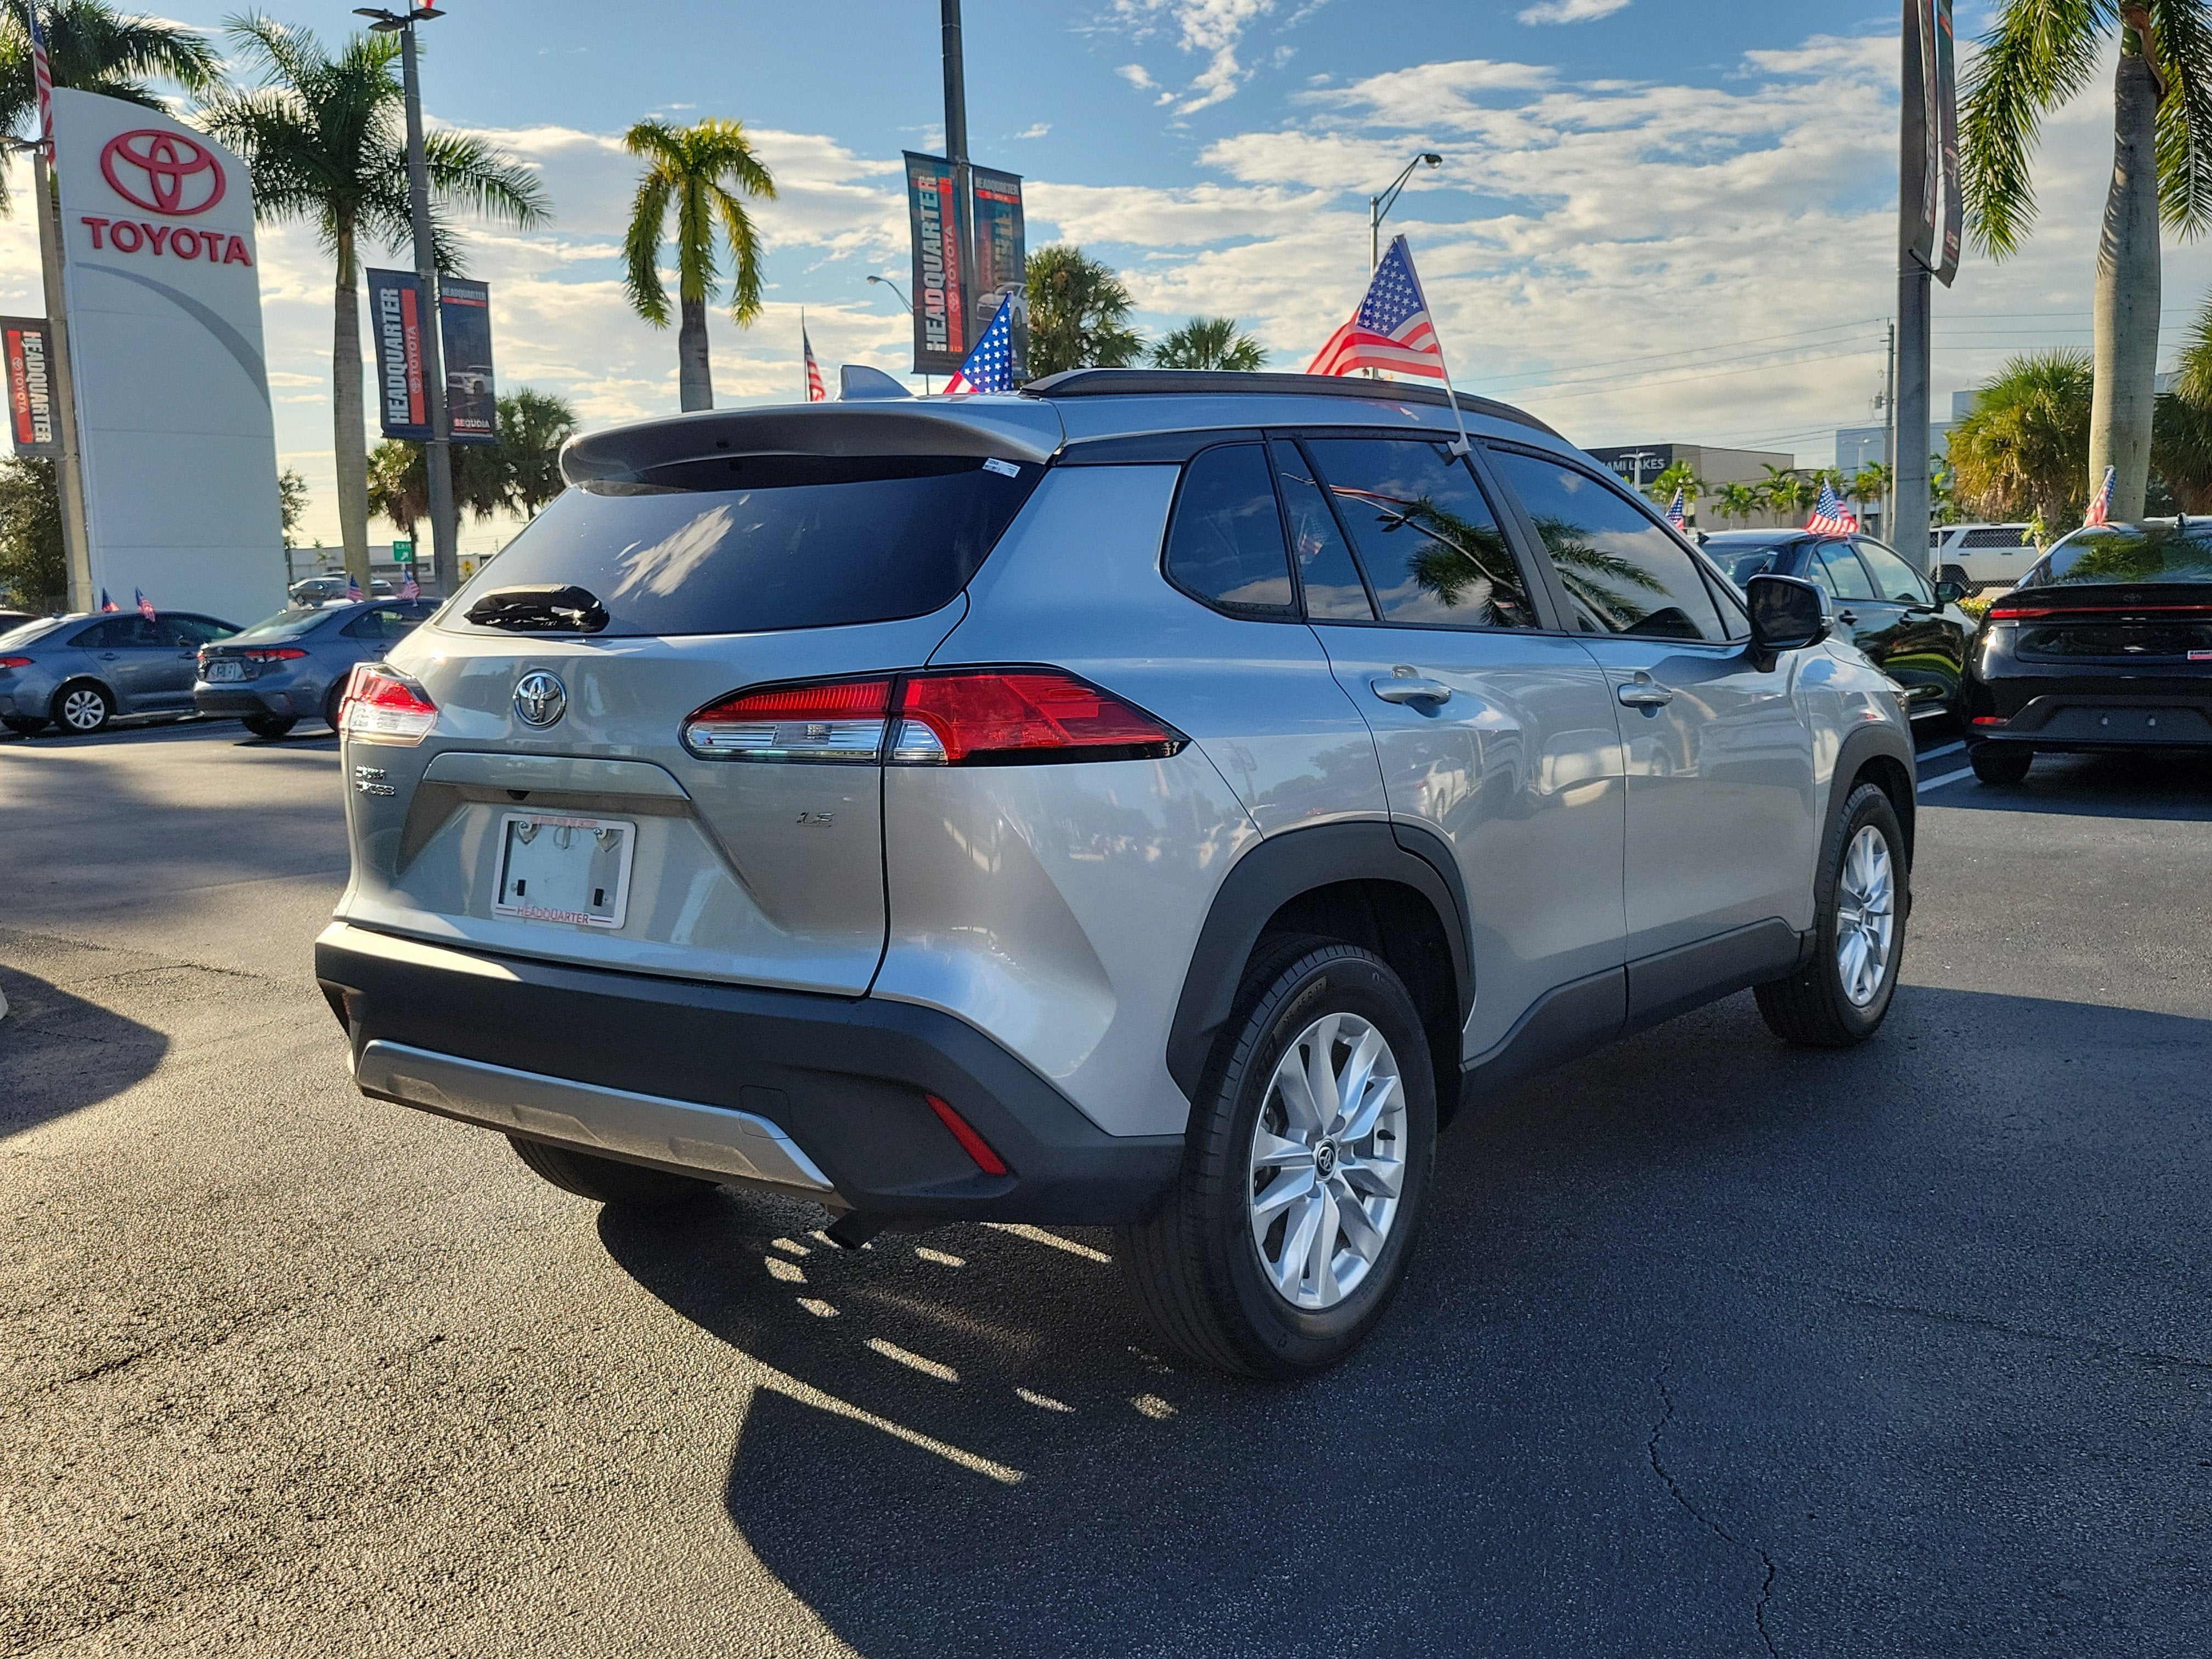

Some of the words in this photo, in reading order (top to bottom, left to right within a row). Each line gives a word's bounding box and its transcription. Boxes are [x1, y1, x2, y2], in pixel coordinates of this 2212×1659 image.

[81, 216, 253, 267] TOYOTA
[918, 176, 947, 352] HEADQUARTER
[944, 225, 957, 290] TOYOTA
[380, 288, 410, 424] HEADQUARTER
[407, 326, 420, 376] TOYOTA
[15, 371, 27, 414] TOYOTA
[23, 331, 52, 443] HEADQUARTER
[1602, 460, 1627, 472] AMI
[517, 905, 589, 924] HEADQUARTER
